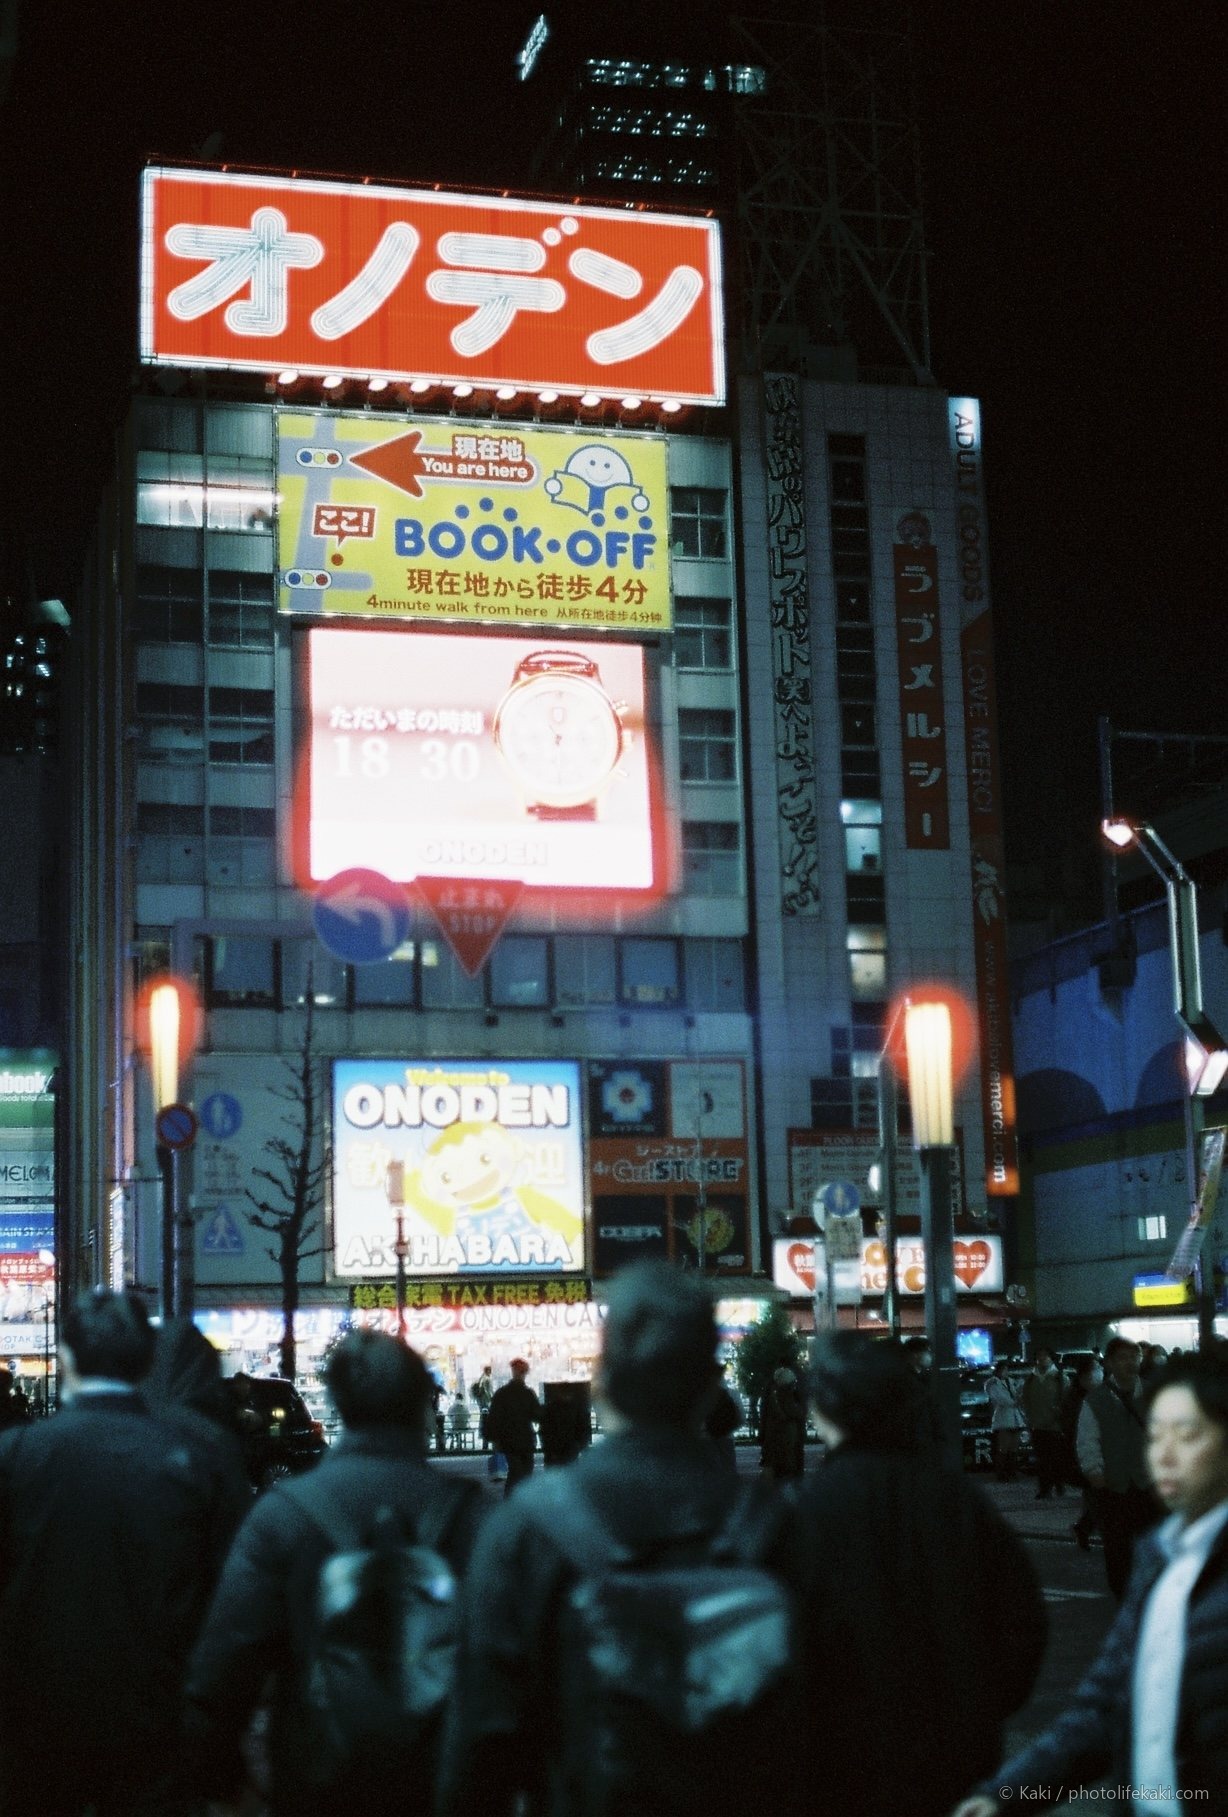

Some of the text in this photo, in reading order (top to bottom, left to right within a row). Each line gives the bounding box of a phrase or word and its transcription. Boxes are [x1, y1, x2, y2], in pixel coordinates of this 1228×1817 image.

[164, 206, 703, 365] オノデン
[454, 435, 524, 462] 現在地
[421, 457, 528, 480] You are here
[406, 567, 649, 606] 現在地から徒歩4分
[435, 599, 470, 614] walk
[474, 601, 510, 616] from
[515, 603, 548, 617] here
[901, 565, 942, 836] ラブメルシー
[330, 706, 485, 735] ただいまの時刻
[343, 1084, 569, 1128] ONODEN
[343, 1235, 572, 1267] AKHABARA
[447, 1284, 486, 1306] TAX
[492, 1283, 540, 1305] FREE
[463, 1306, 562, 1330] ONODEN
